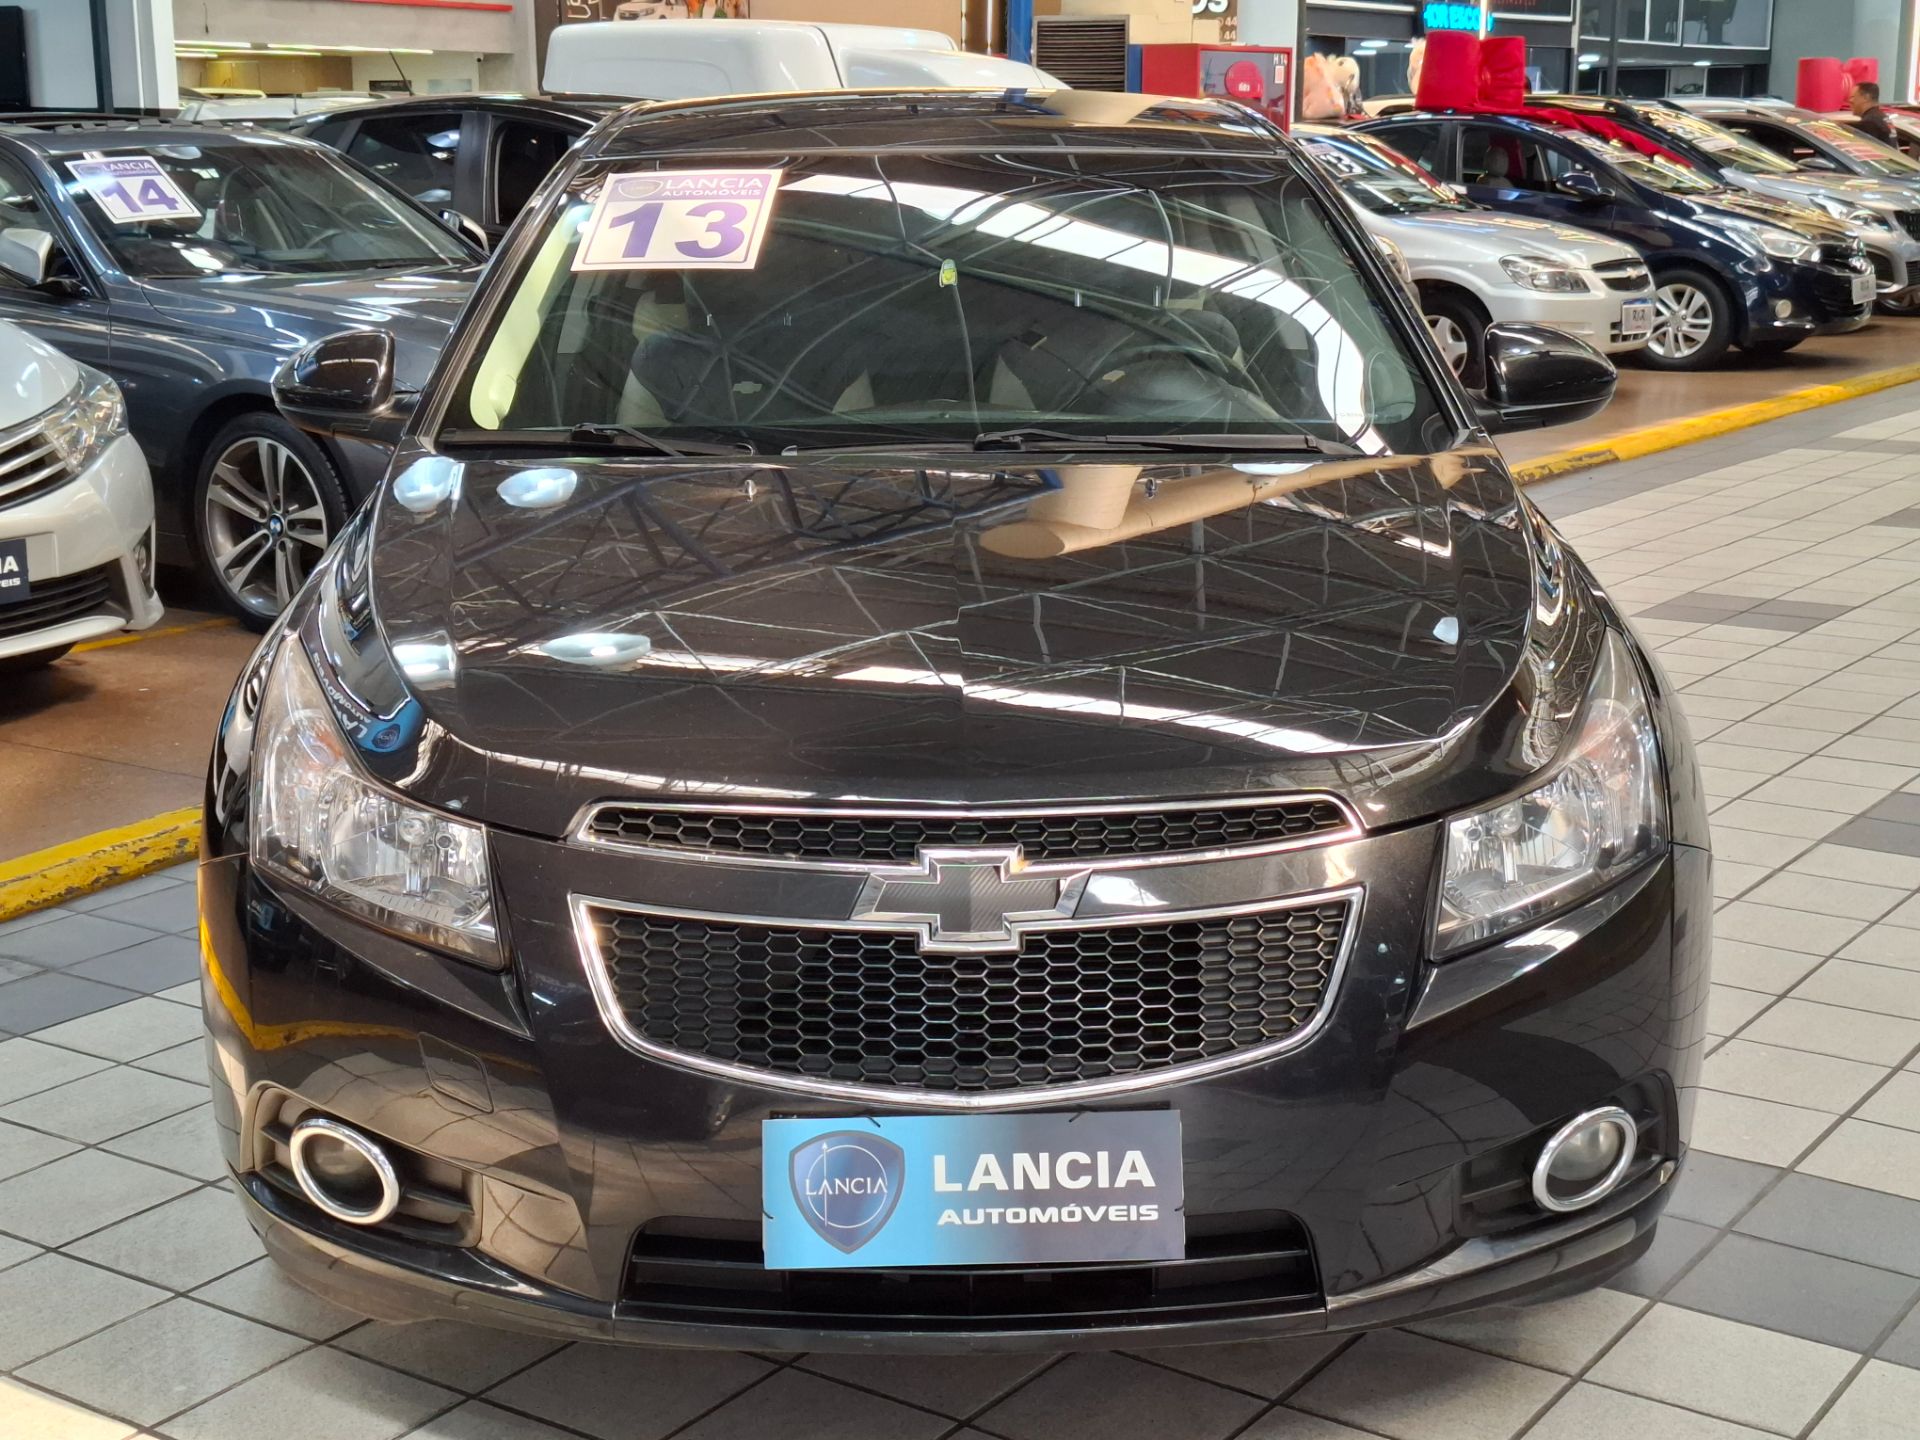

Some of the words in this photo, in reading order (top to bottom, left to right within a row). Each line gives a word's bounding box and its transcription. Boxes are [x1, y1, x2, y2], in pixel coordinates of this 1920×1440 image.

[101, 178, 180, 213] 14
[665, 177, 764, 190] LANCIA
[608, 202, 748, 259] 13
[932, 1150, 1157, 1192] LANCIA
[804, 1177, 888, 1197] LANCIA
[936, 1203, 1160, 1226] AUTOMÓVEIS
